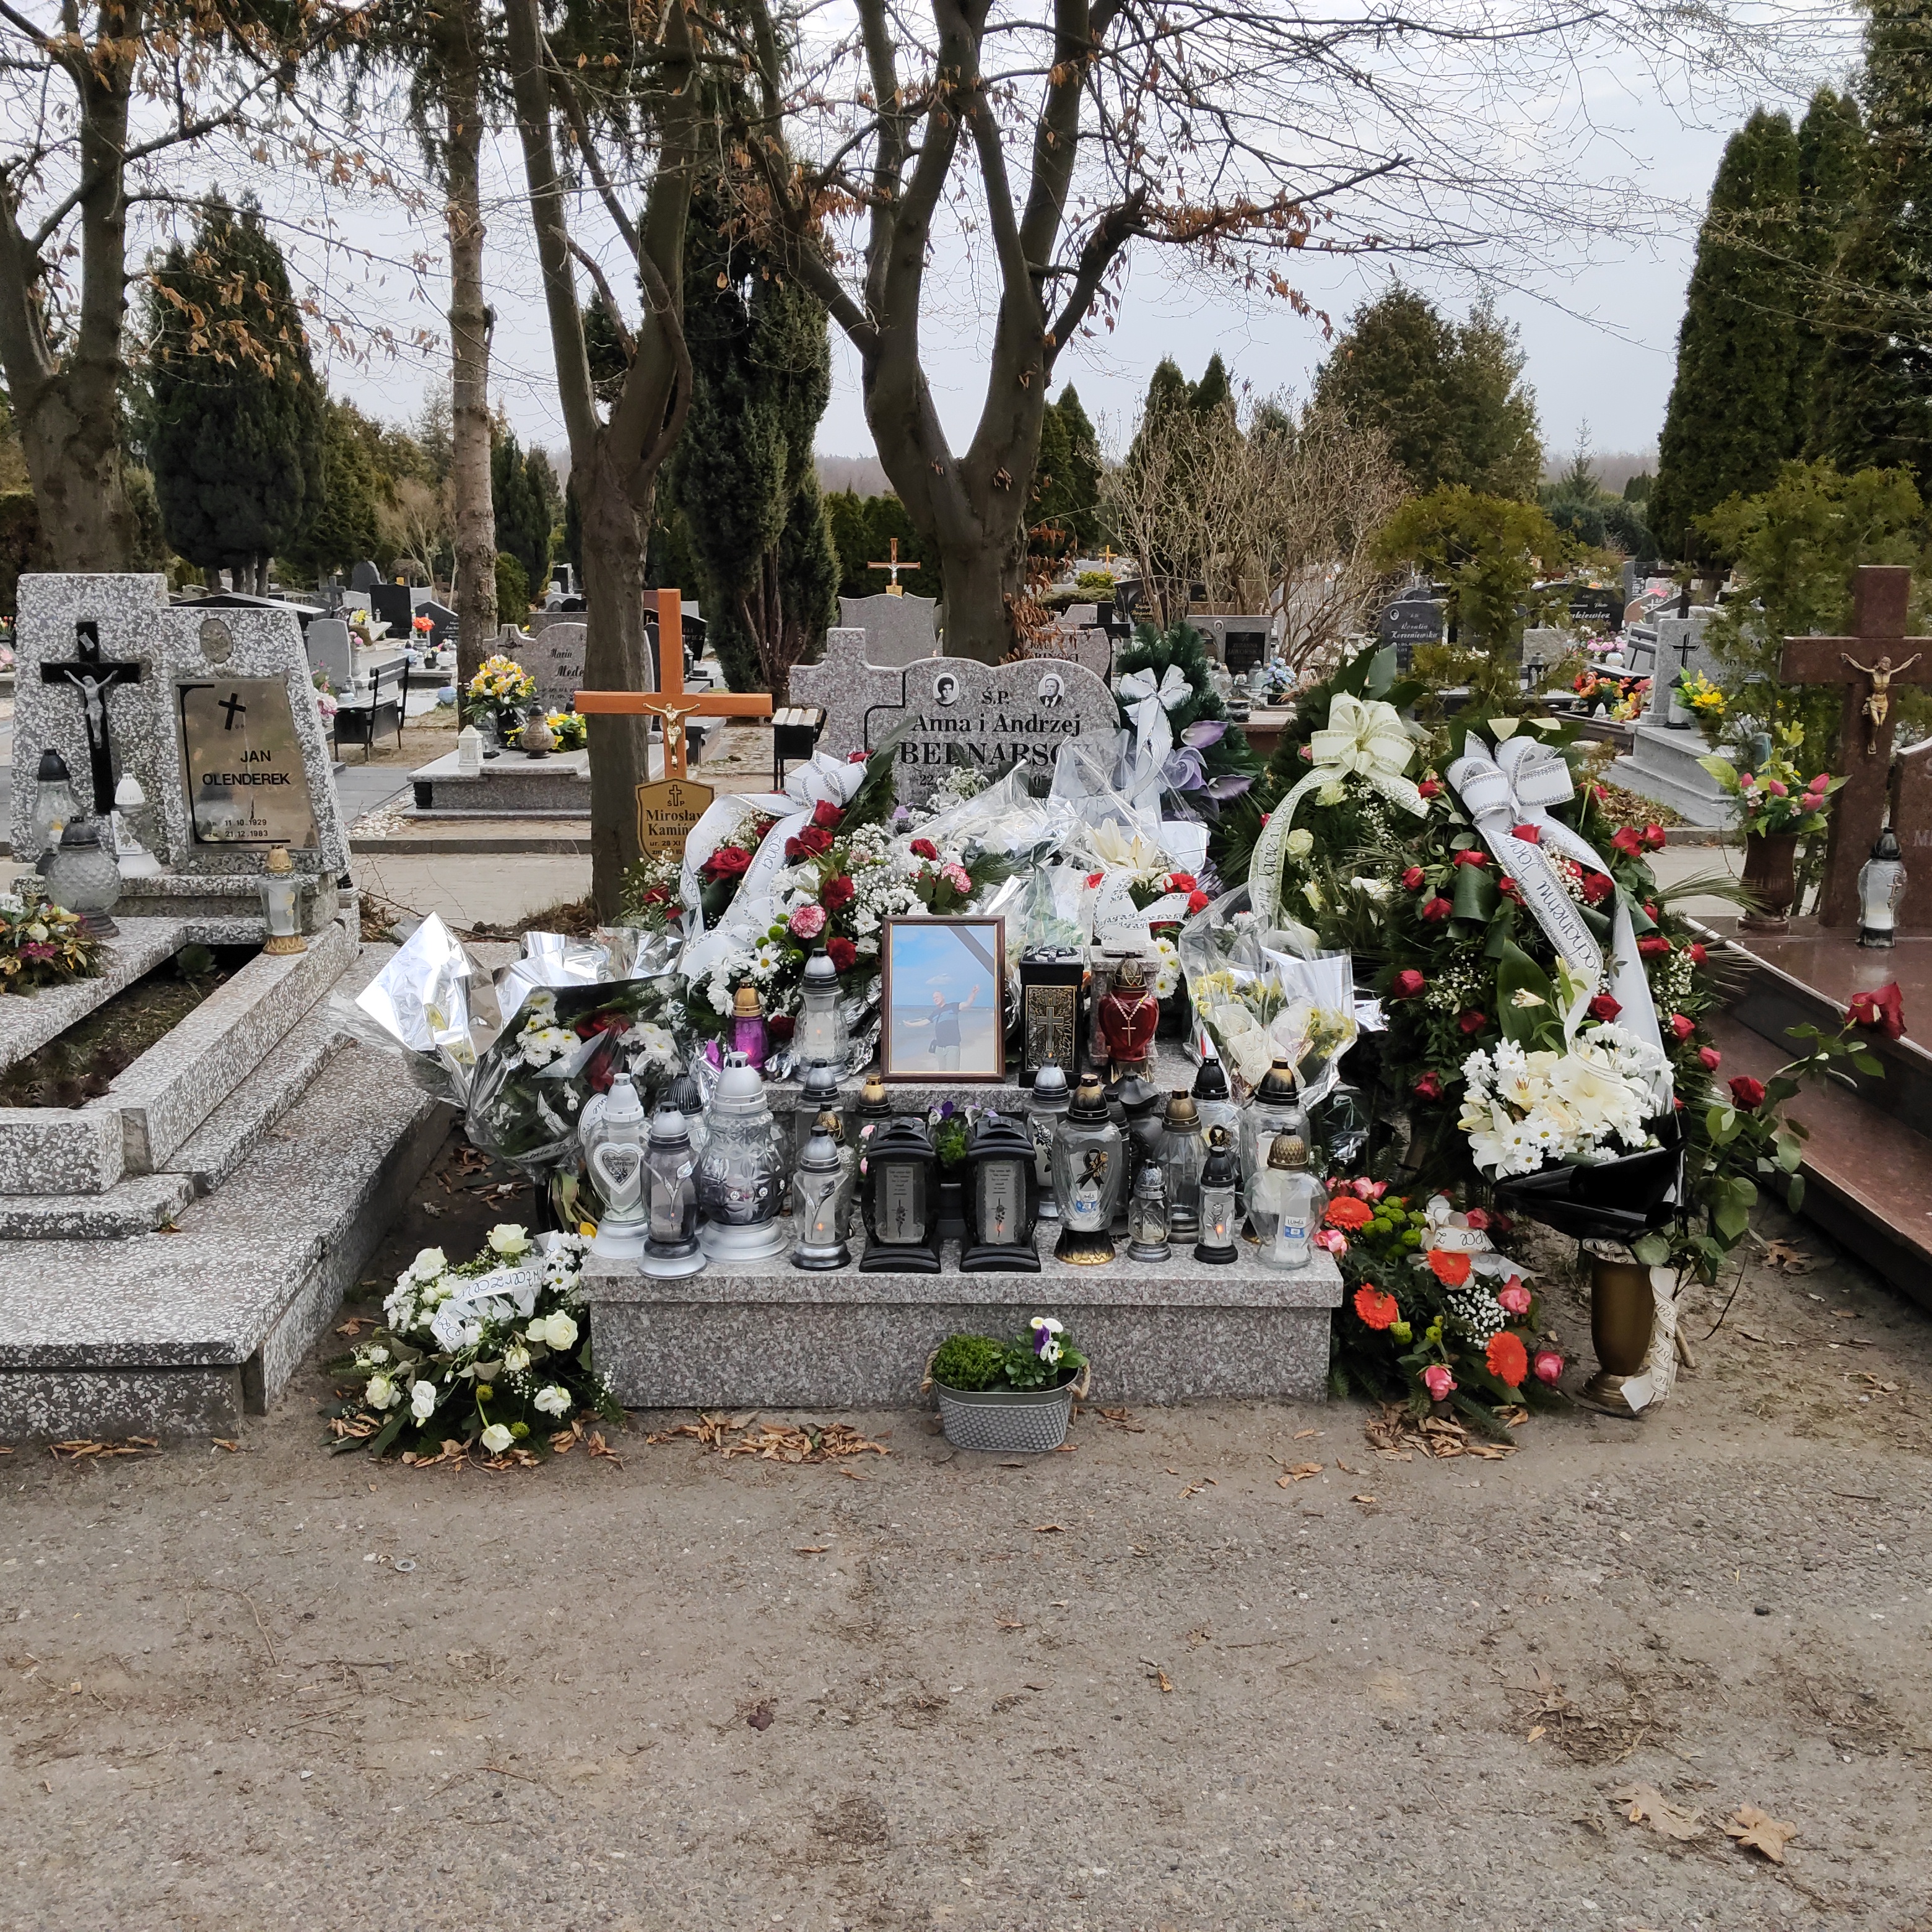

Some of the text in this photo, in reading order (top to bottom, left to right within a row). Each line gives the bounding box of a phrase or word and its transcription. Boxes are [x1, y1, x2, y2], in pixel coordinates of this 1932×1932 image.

[912, 713, 1081, 737] Anna i Andrzej
[240, 750, 272, 763] JAN
[202, 773, 291, 786] OLENDEREK
[648, 823, 694, 836] Kamiń
[1536, 880, 1598, 970] ochanemu
